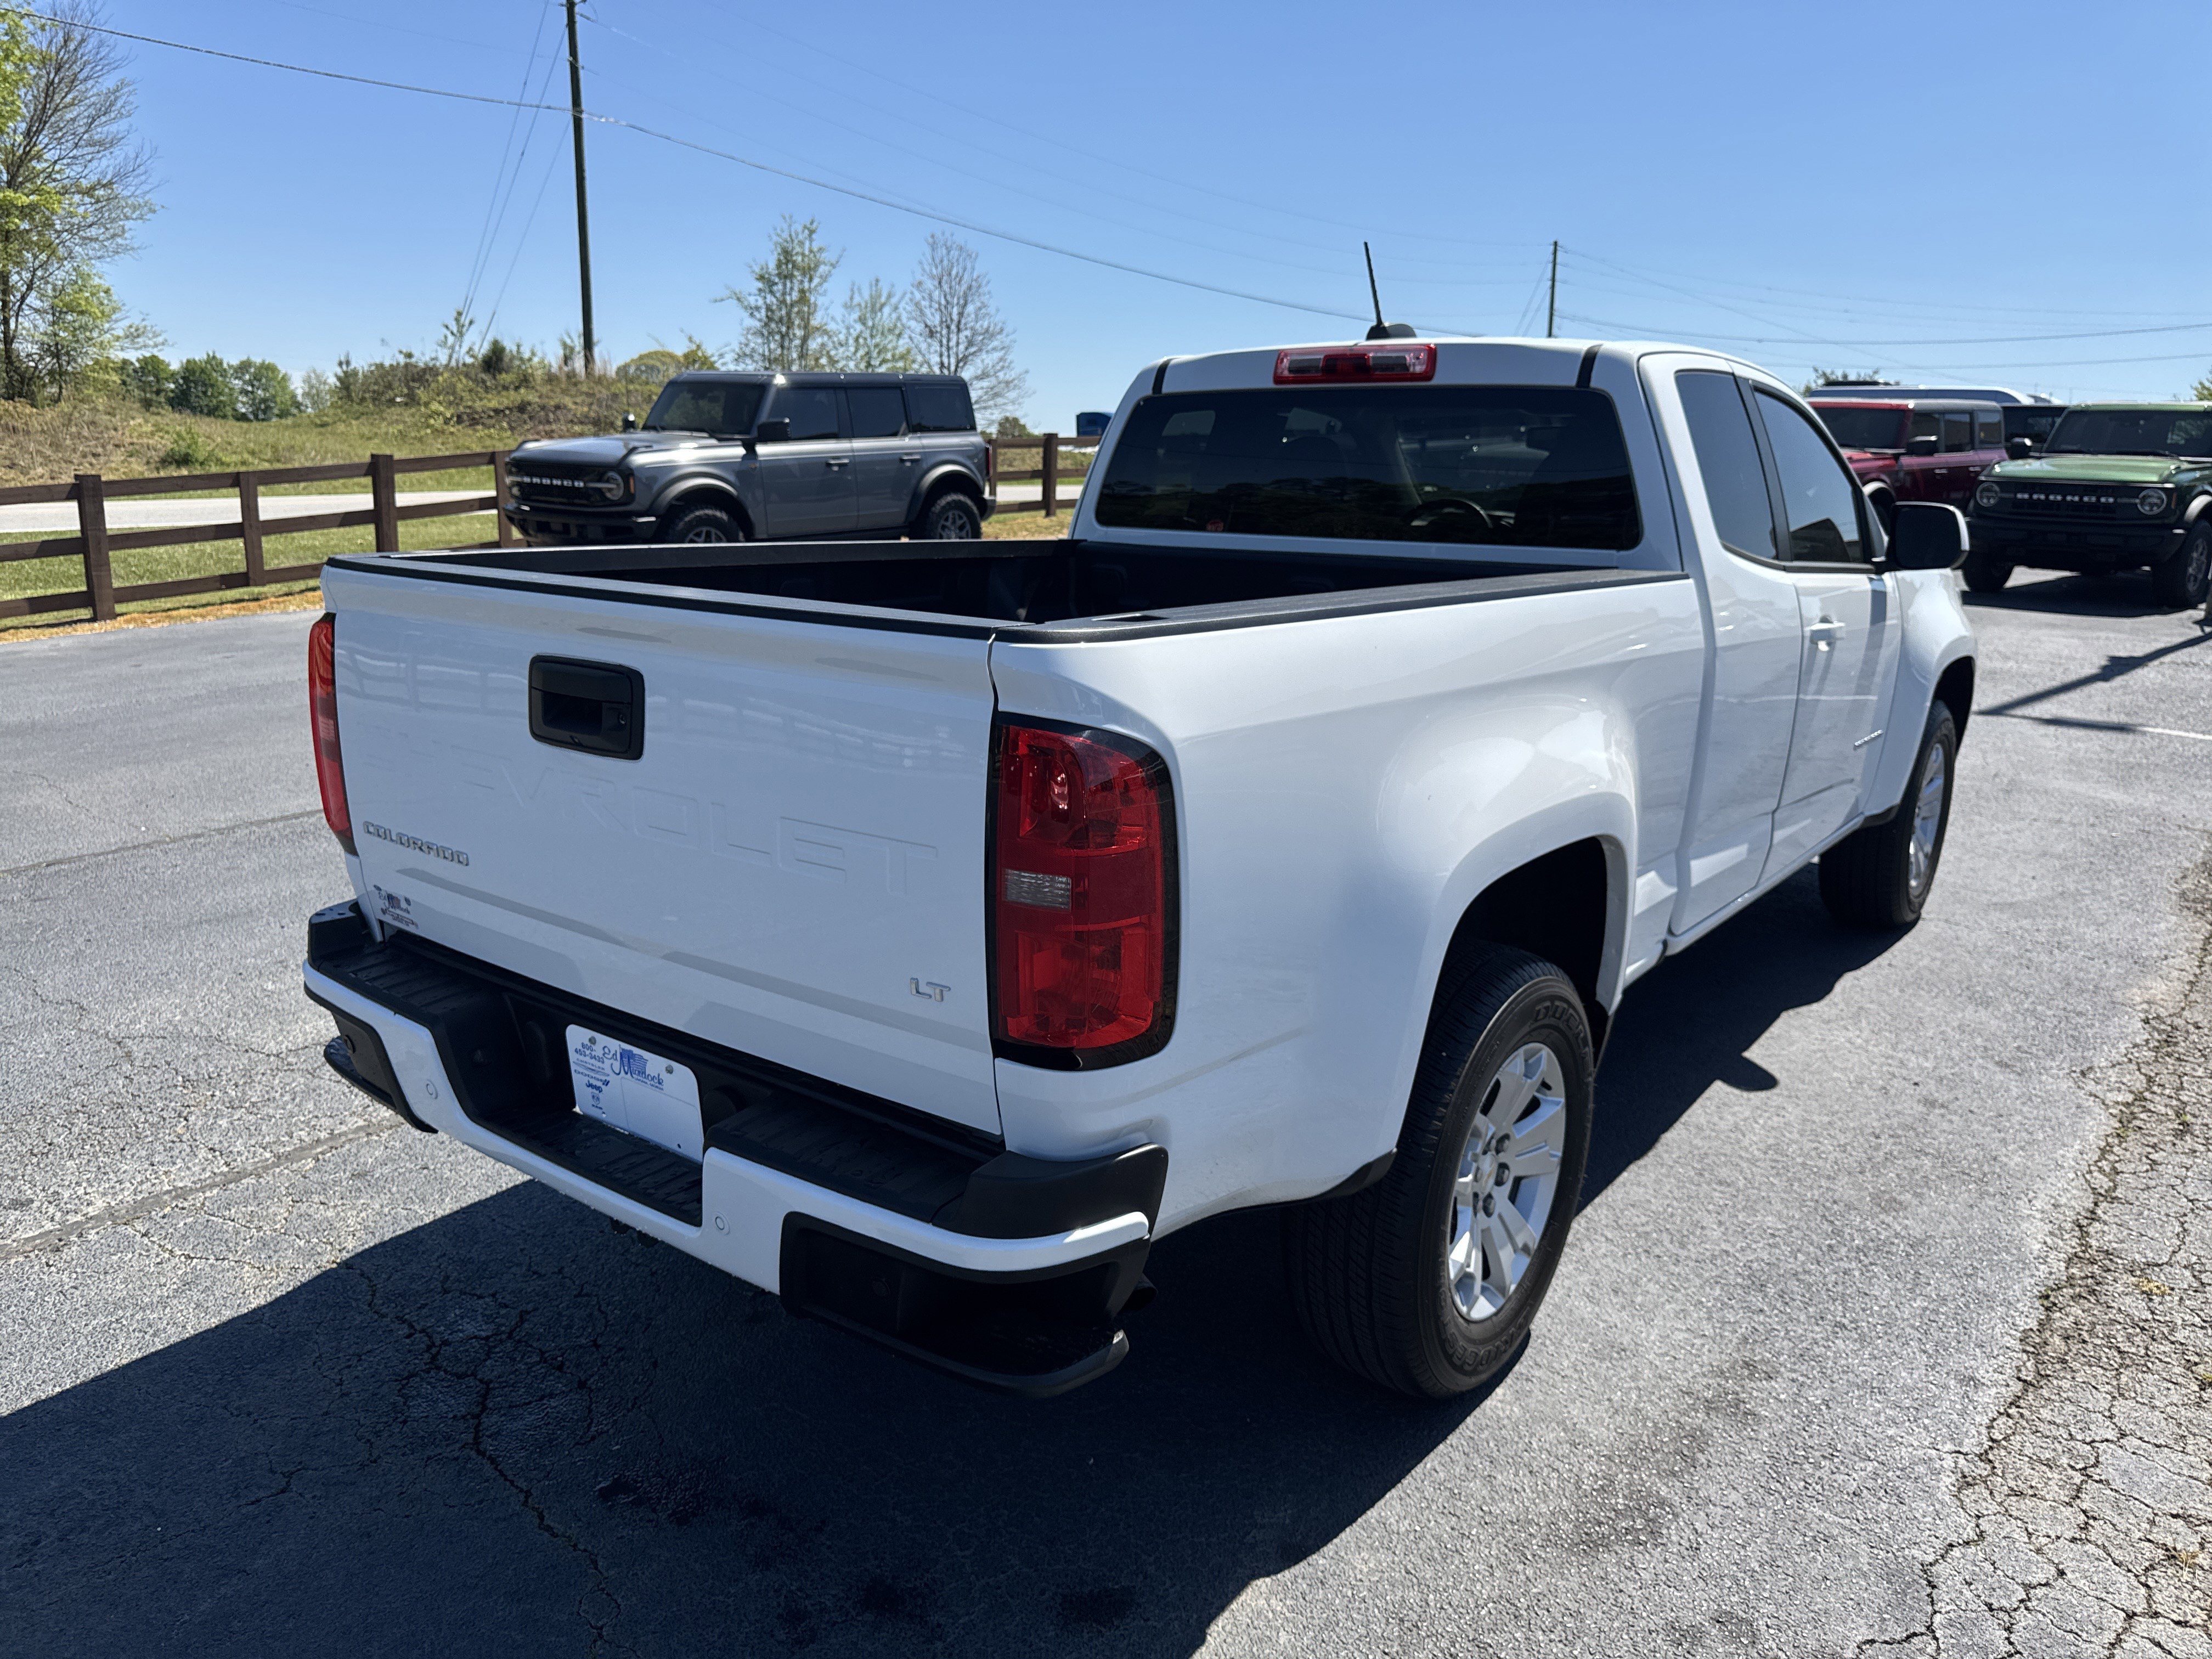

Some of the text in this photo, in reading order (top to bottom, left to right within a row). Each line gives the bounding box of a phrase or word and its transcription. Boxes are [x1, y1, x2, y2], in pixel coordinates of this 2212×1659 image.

[523, 475, 585, 488] BRONCO
[2016, 493, 2115, 504] BRONCO
[363, 820, 470, 866] COLORADO
[910, 977, 951, 1002] LT
[602, 1046, 618, 1062] Ed
[586, 1080, 603, 1093] Jeep
